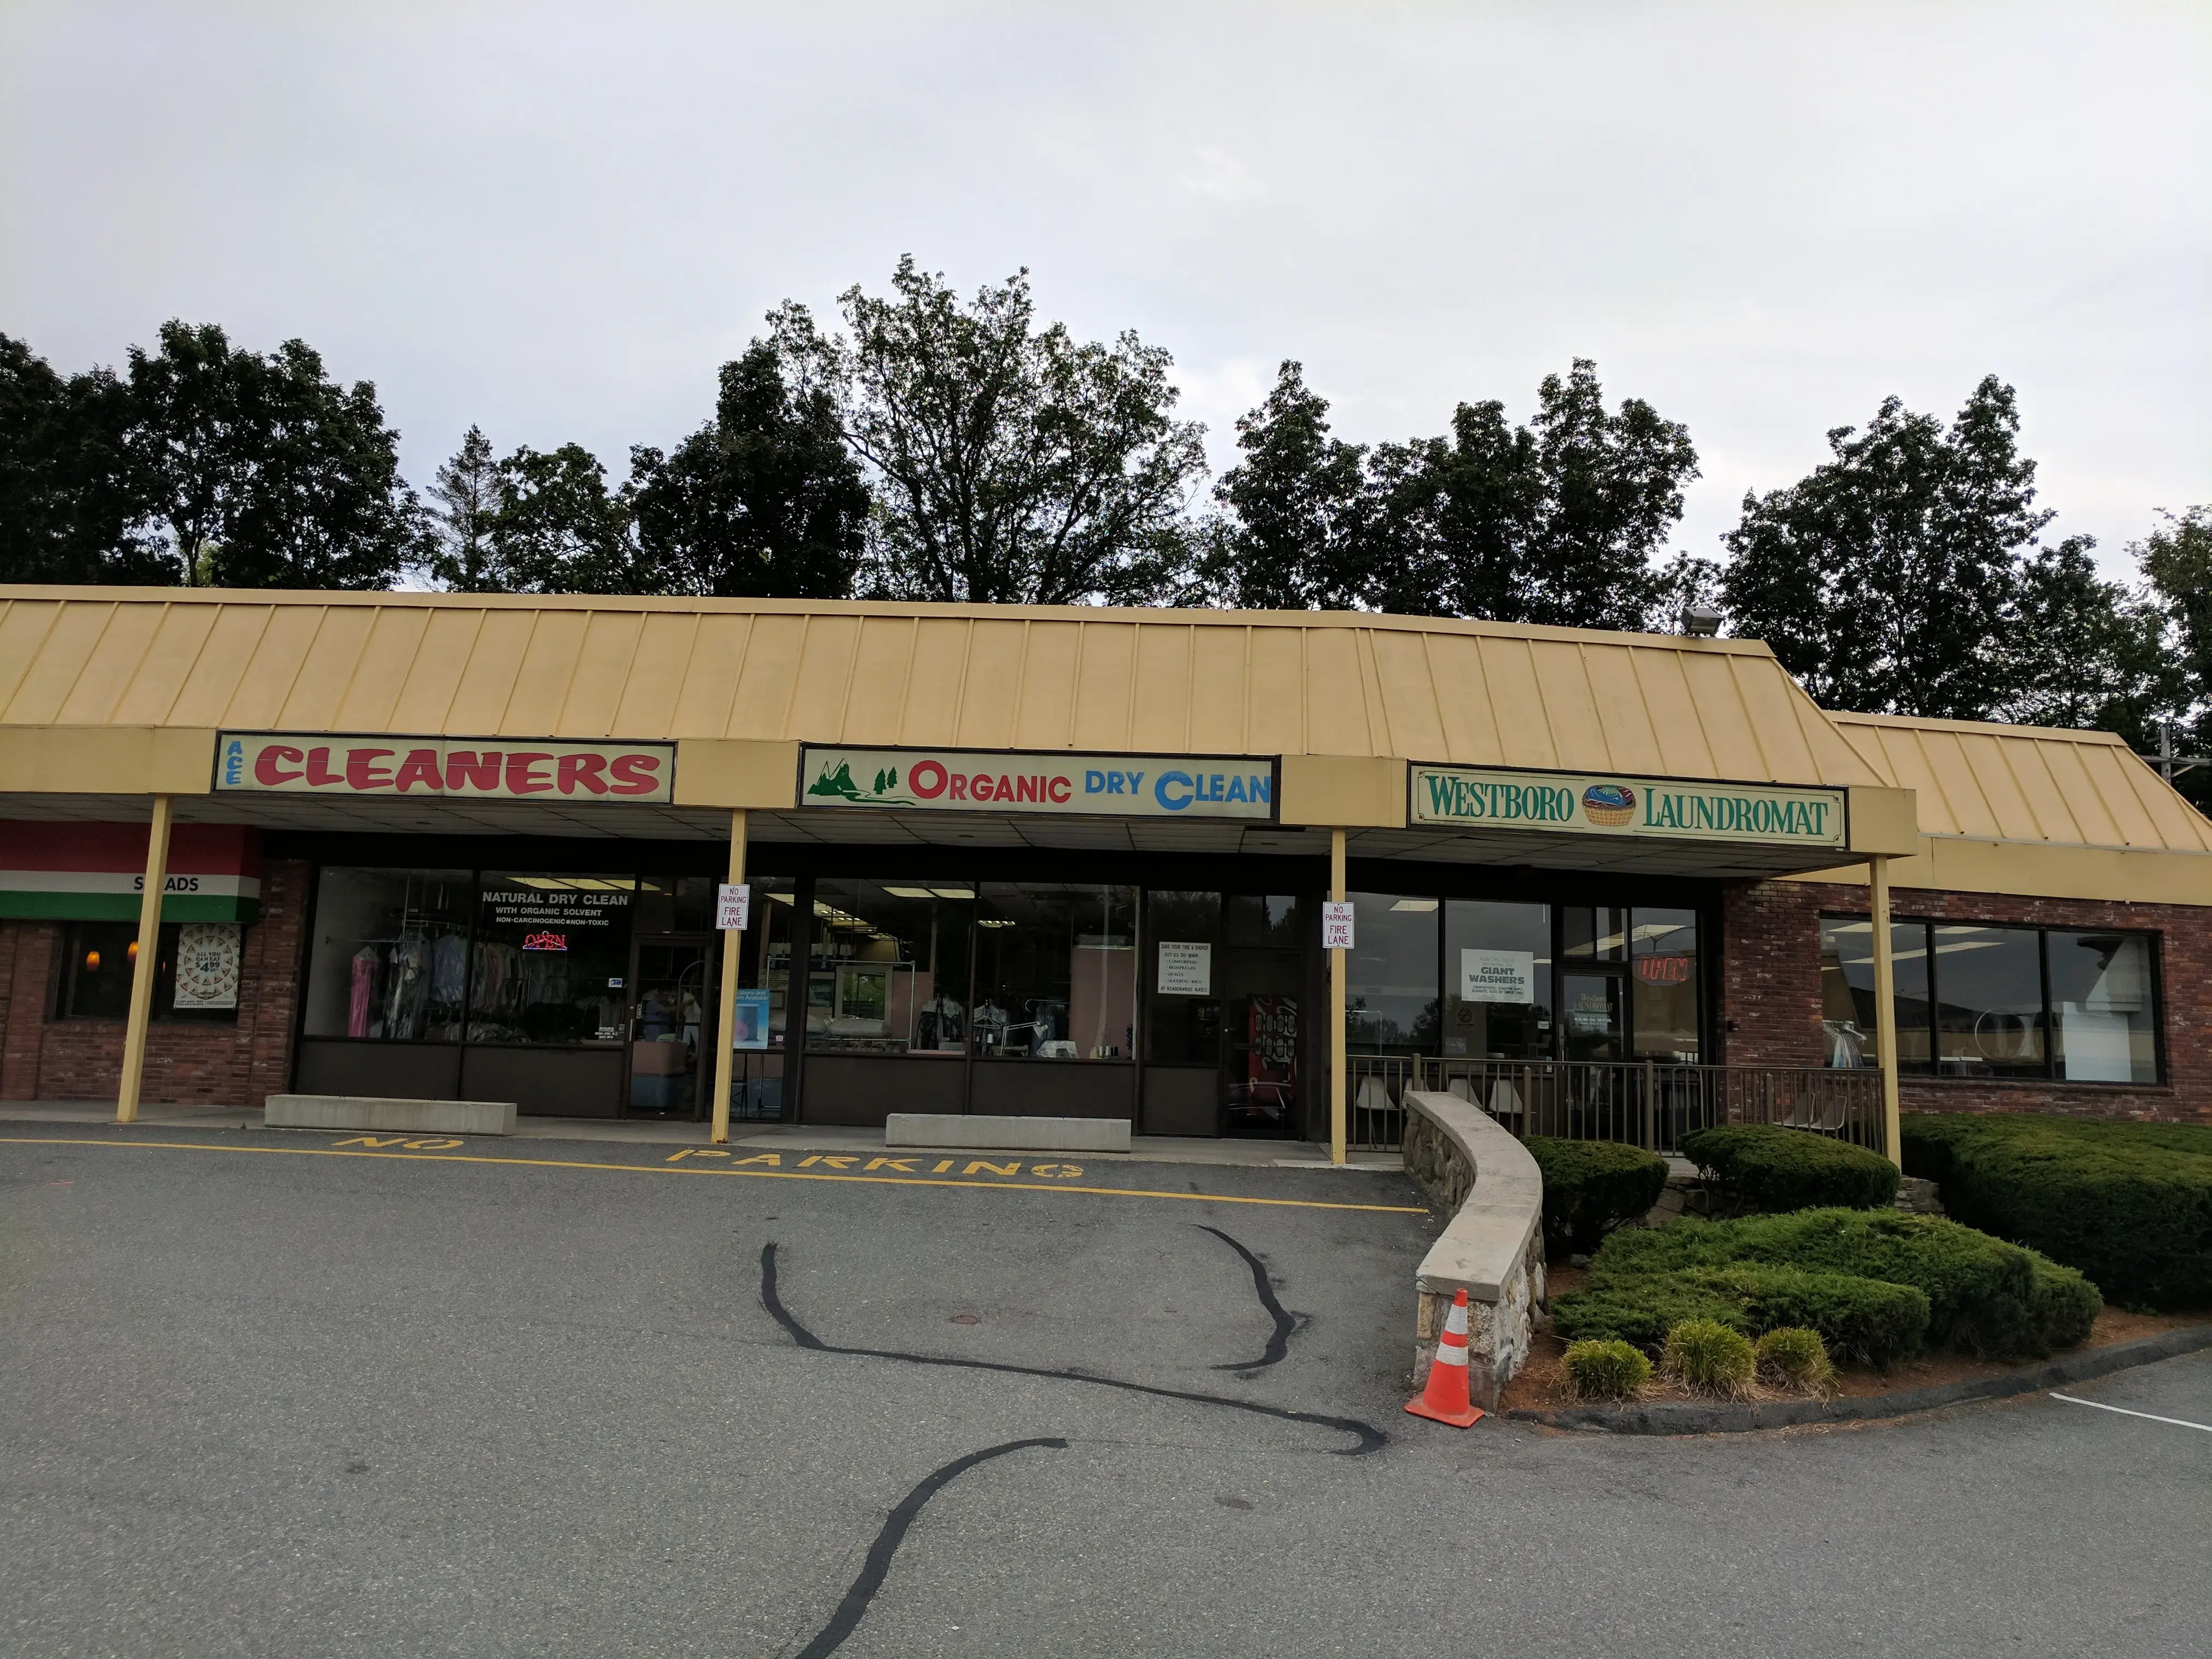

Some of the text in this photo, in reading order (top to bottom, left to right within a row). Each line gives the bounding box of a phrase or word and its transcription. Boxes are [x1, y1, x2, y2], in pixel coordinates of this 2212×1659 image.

[226, 740, 243, 785] ACE
[255, 745, 660, 795] CLEANERS
[908, 760, 1270, 811] ORGANIC DRY CLEAN
[1425, 775, 1828, 836] WESTBORO LAUNDROMAT
[134, 876, 198, 891] SADS
[483, 891, 628, 905] NATURAL DRY CLEAN
[520, 907, 560, 915] ORGANIC
[563, 908, 602, 916] SOLVENT
[724, 907, 741, 916] FIRE
[1325, 914, 1351, 922] PARKING
[721, 917, 743, 926] LANE
[1330, 925, 1347, 934] FIRE
[525, 934, 566, 948] OPEN
[1328, 936, 1349, 944] LANE
[1480, 967, 1515, 975] GIANT
[1639, 957, 1687, 982] OPEN
[1468, 974, 1525, 984] WASHERS
[331, 1137, 1085, 1178] NO PARKING
